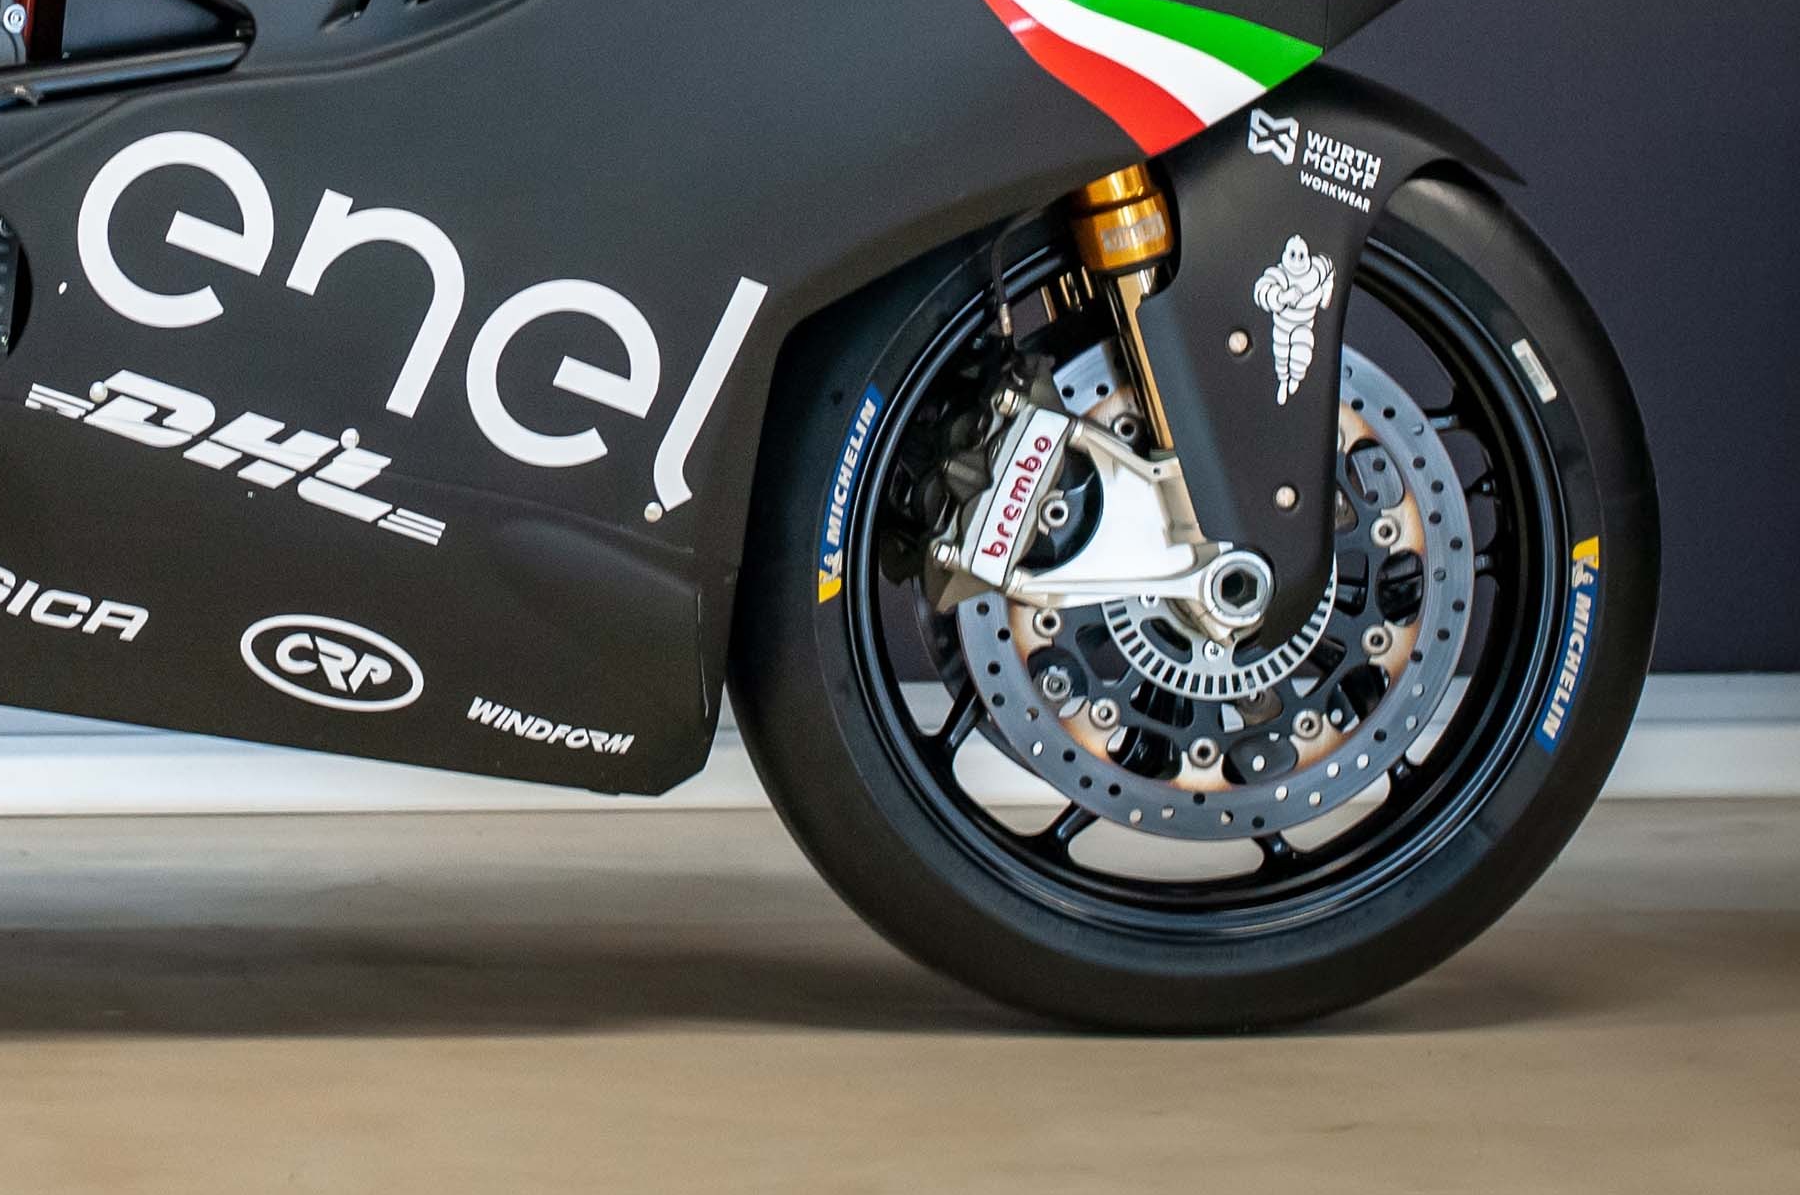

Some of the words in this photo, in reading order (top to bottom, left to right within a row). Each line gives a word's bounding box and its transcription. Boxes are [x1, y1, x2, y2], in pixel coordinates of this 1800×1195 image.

[1300, 170, 1372, 213] WORKWEAR
[1302, 147, 1376, 191] MODYF
[1306, 129, 1382, 179] WURTH
[77, 130, 769, 512] enel
[82, 368, 394, 524] DHL
[826, 396, 878, 547] MICHELIN
[981, 435, 1053, 559] brembo
[274, 632, 394, 695] CRP
[1541, 590, 1593, 740] MICHELIN
[465, 695, 637, 757] WINDFORM
